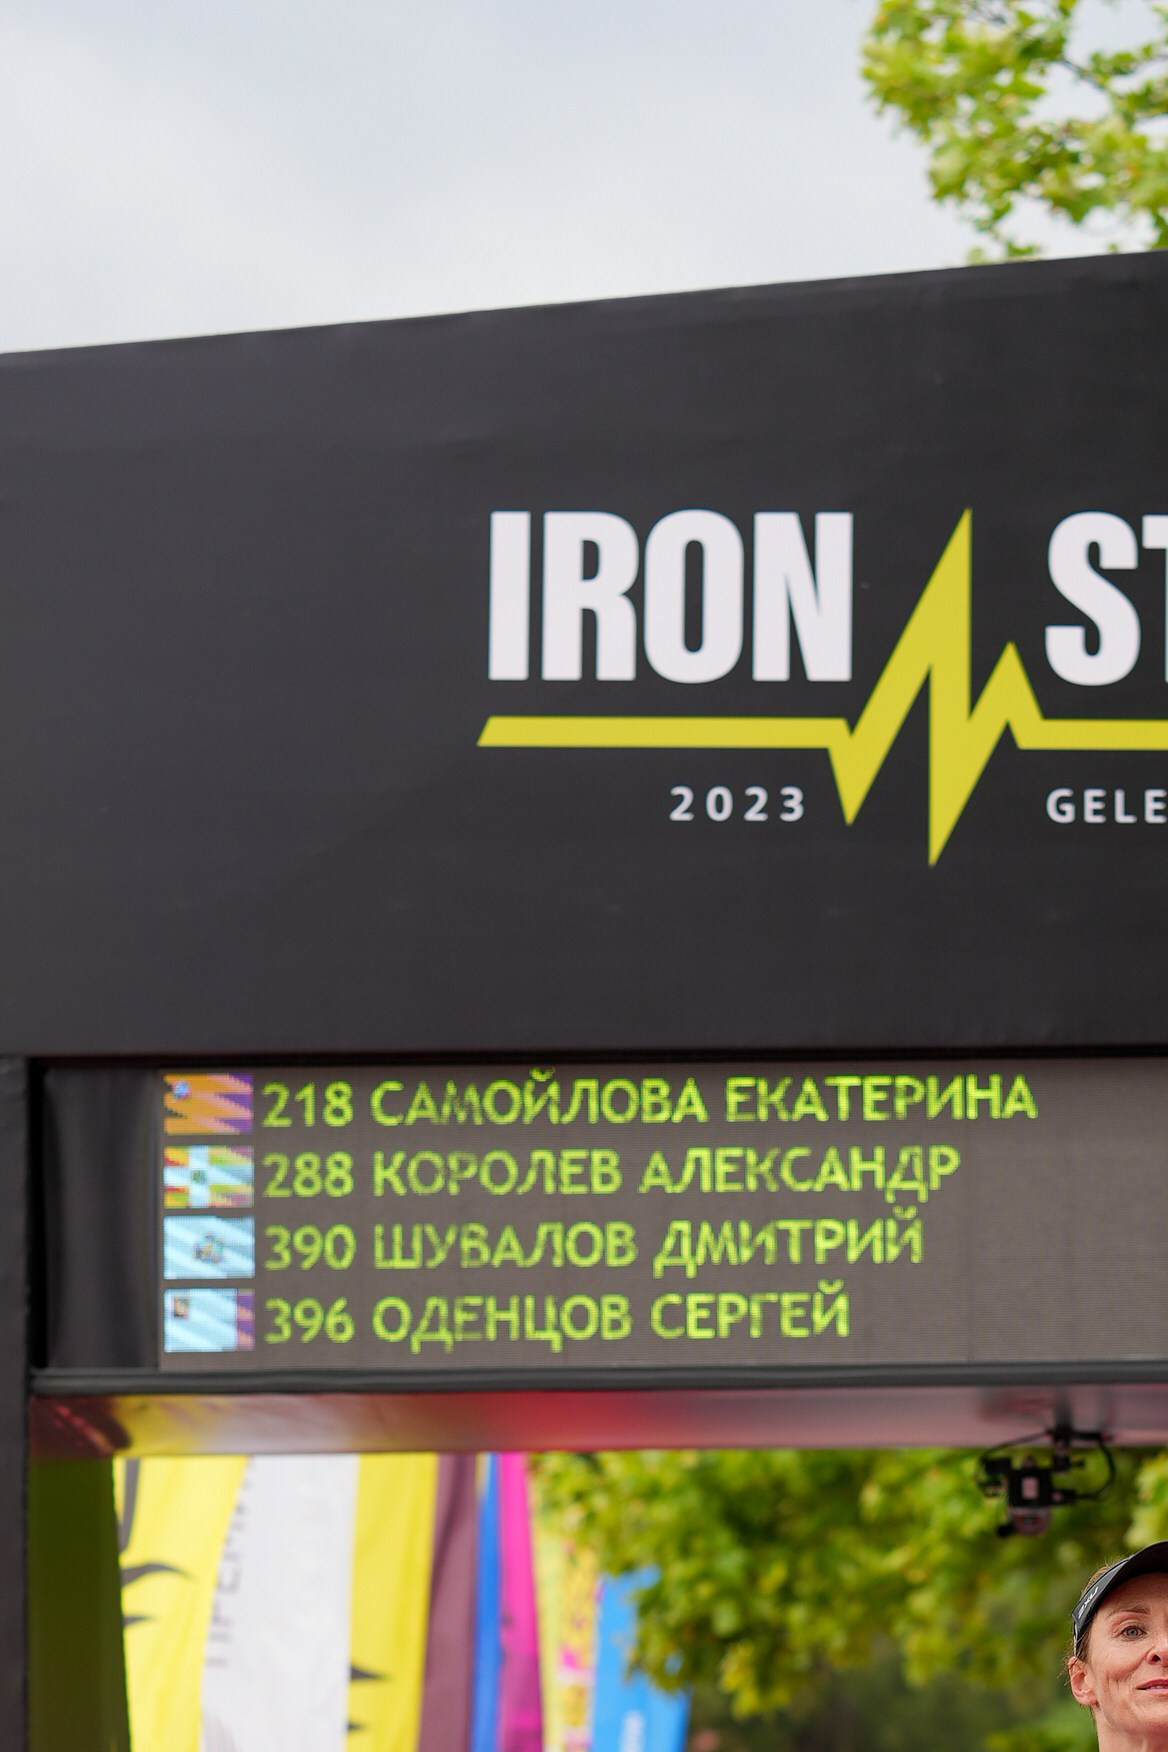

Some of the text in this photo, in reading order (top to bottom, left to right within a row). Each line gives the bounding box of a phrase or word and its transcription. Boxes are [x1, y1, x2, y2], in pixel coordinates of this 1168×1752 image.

[488, 509, 853, 684] IRON
[669, 786, 804, 822] 2023
[262, 1081, 354, 1128] 218
[369, 1068, 709, 1126] САМОЙЛОВА
[725, 1074, 1038, 1122] ЕКАТЕРИНА
[263, 1150, 353, 1197] 288
[372, 1147, 622, 1195] КОРОЛЕВ
[639, 1144, 961, 1202] АЛЕКСАНДР
[265, 1223, 356, 1269] 390
[373, 1220, 636, 1269] ШУВАЛОВ
[653, 1204, 923, 1278] ДМИТРИЙ
[266, 1297, 355, 1343] 396
[371, 1292, 633, 1352] ОДЕНЦОВ
[650, 1276, 850, 1338] СЕРГЕЙ
